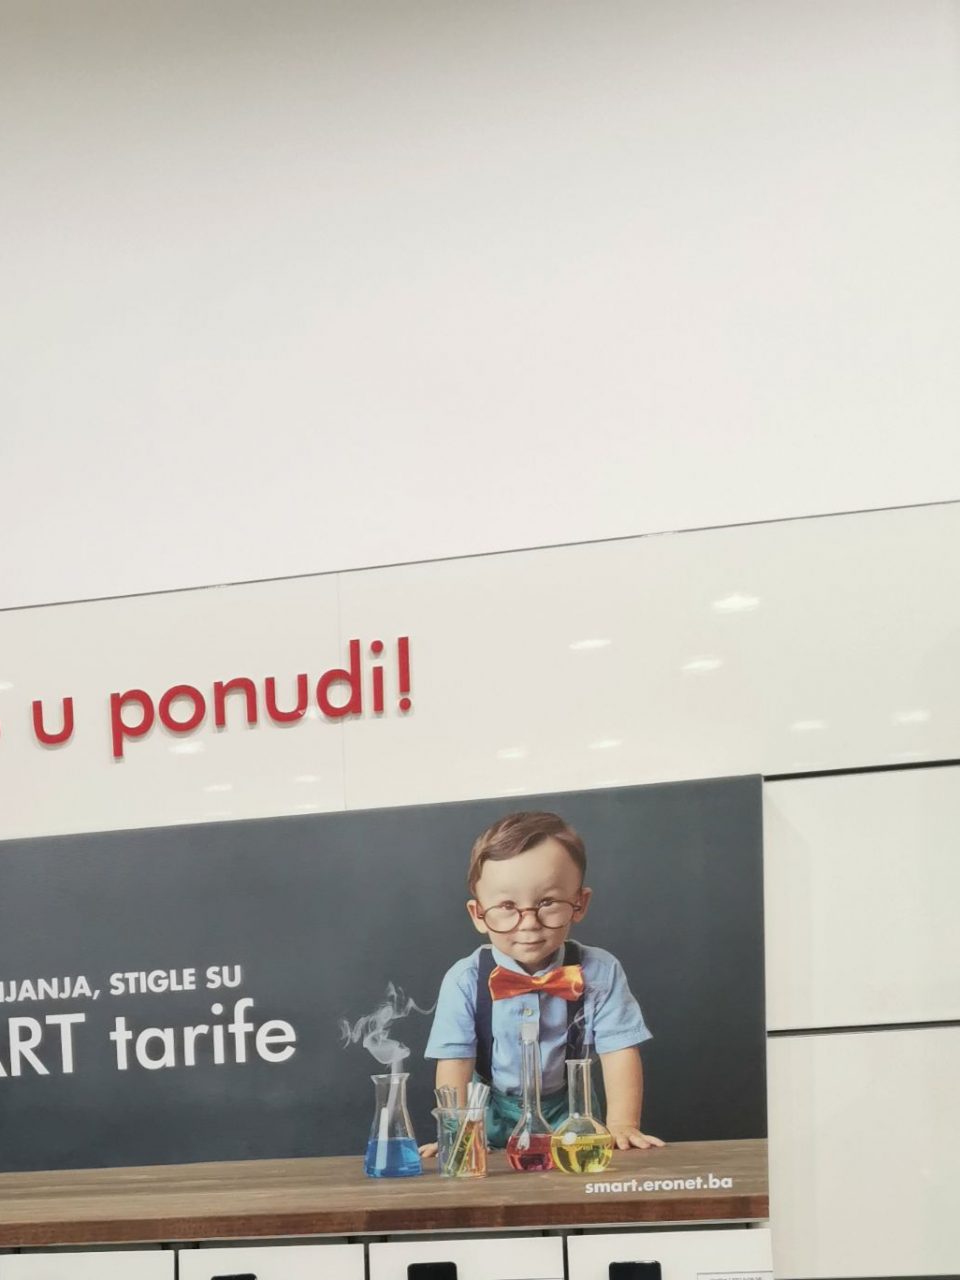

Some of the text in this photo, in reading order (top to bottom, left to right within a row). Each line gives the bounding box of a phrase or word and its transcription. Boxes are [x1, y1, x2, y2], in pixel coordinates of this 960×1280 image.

[32, 697, 74, 746] u
[110, 636, 411, 759] ponudi!
[109, 967, 197, 996] STIGLE
[205, 964, 242, 989] SU
[109, 997, 297, 1071] tarife
[585, 1173, 733, 1194] smart.eronet.ba
